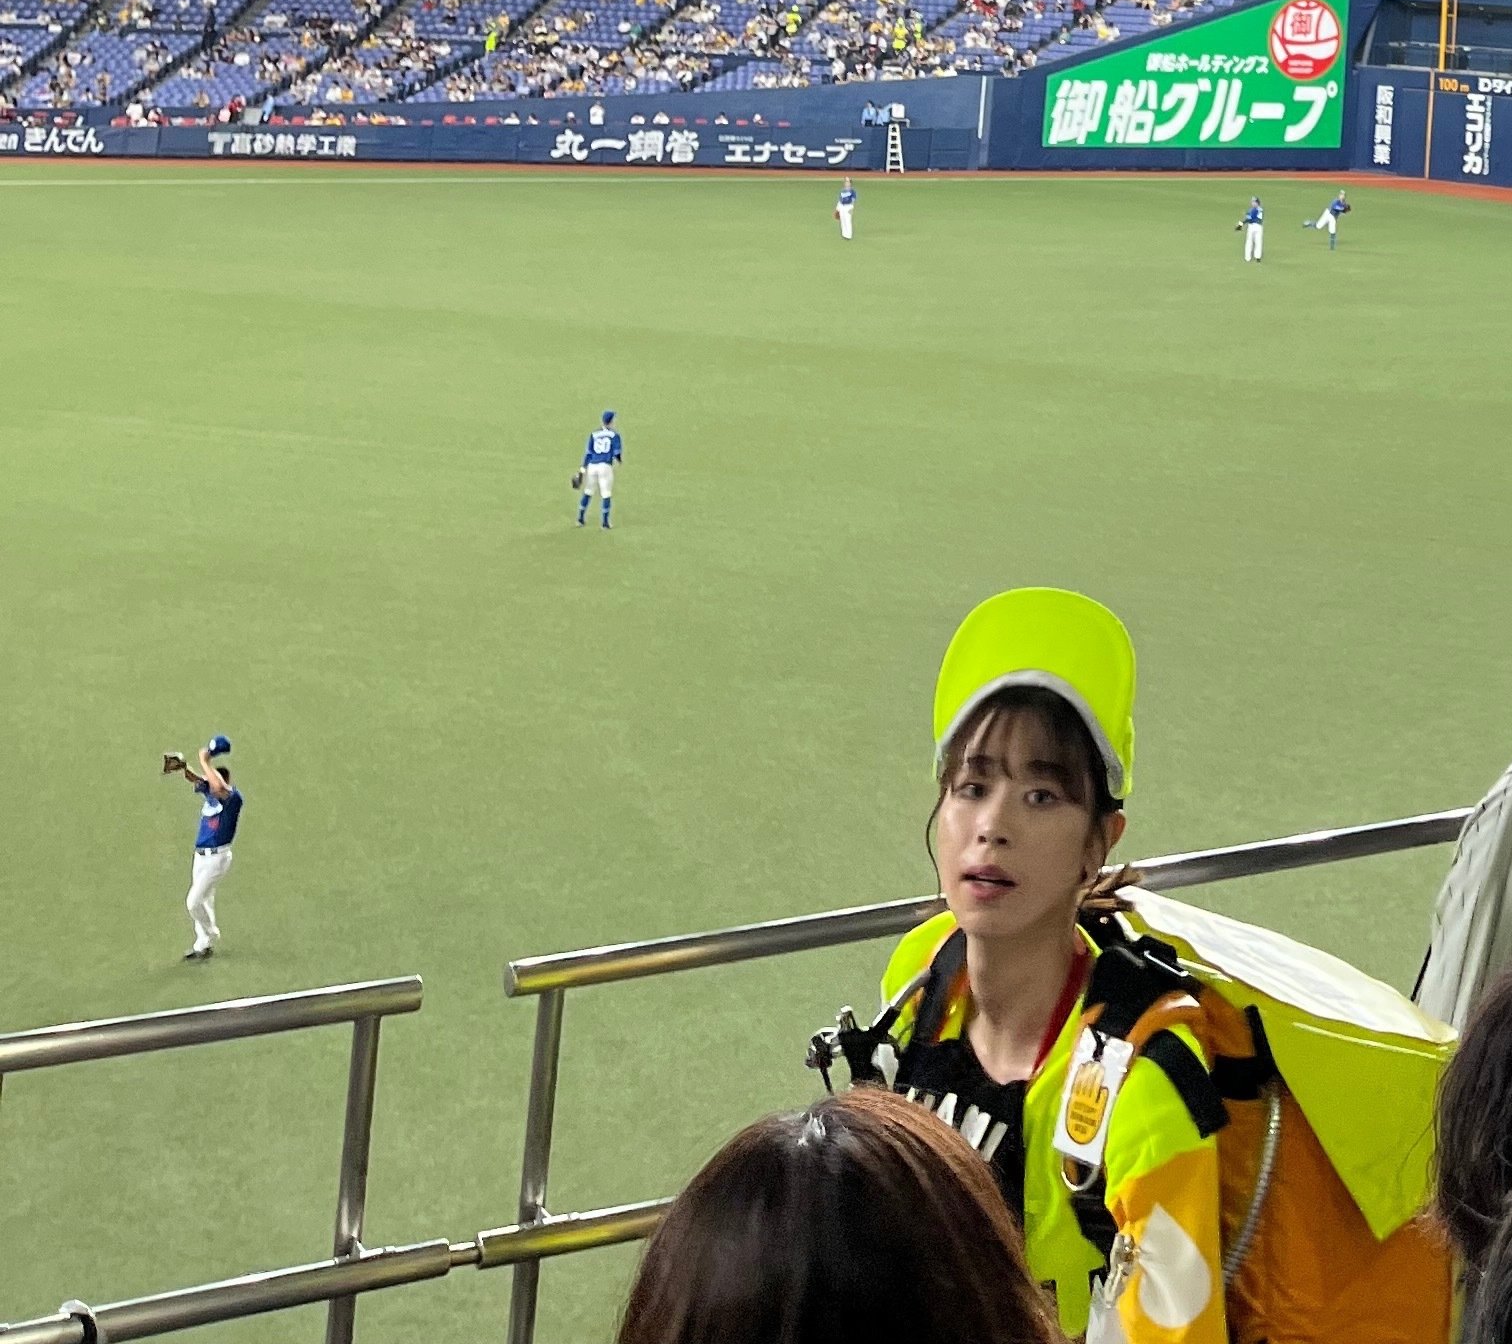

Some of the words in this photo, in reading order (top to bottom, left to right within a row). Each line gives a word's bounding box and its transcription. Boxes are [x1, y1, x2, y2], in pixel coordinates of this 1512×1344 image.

[1438, 77, 1459, 92] 100
[1048, 77, 1339, 145] 御船グループ
[23, 126, 104, 154] きんでん
[550, 128, 700, 164] 丸一鋼管
[1462, 93, 1486, 176] エコリカ
[724, 140, 855, 165] エナセーブ
